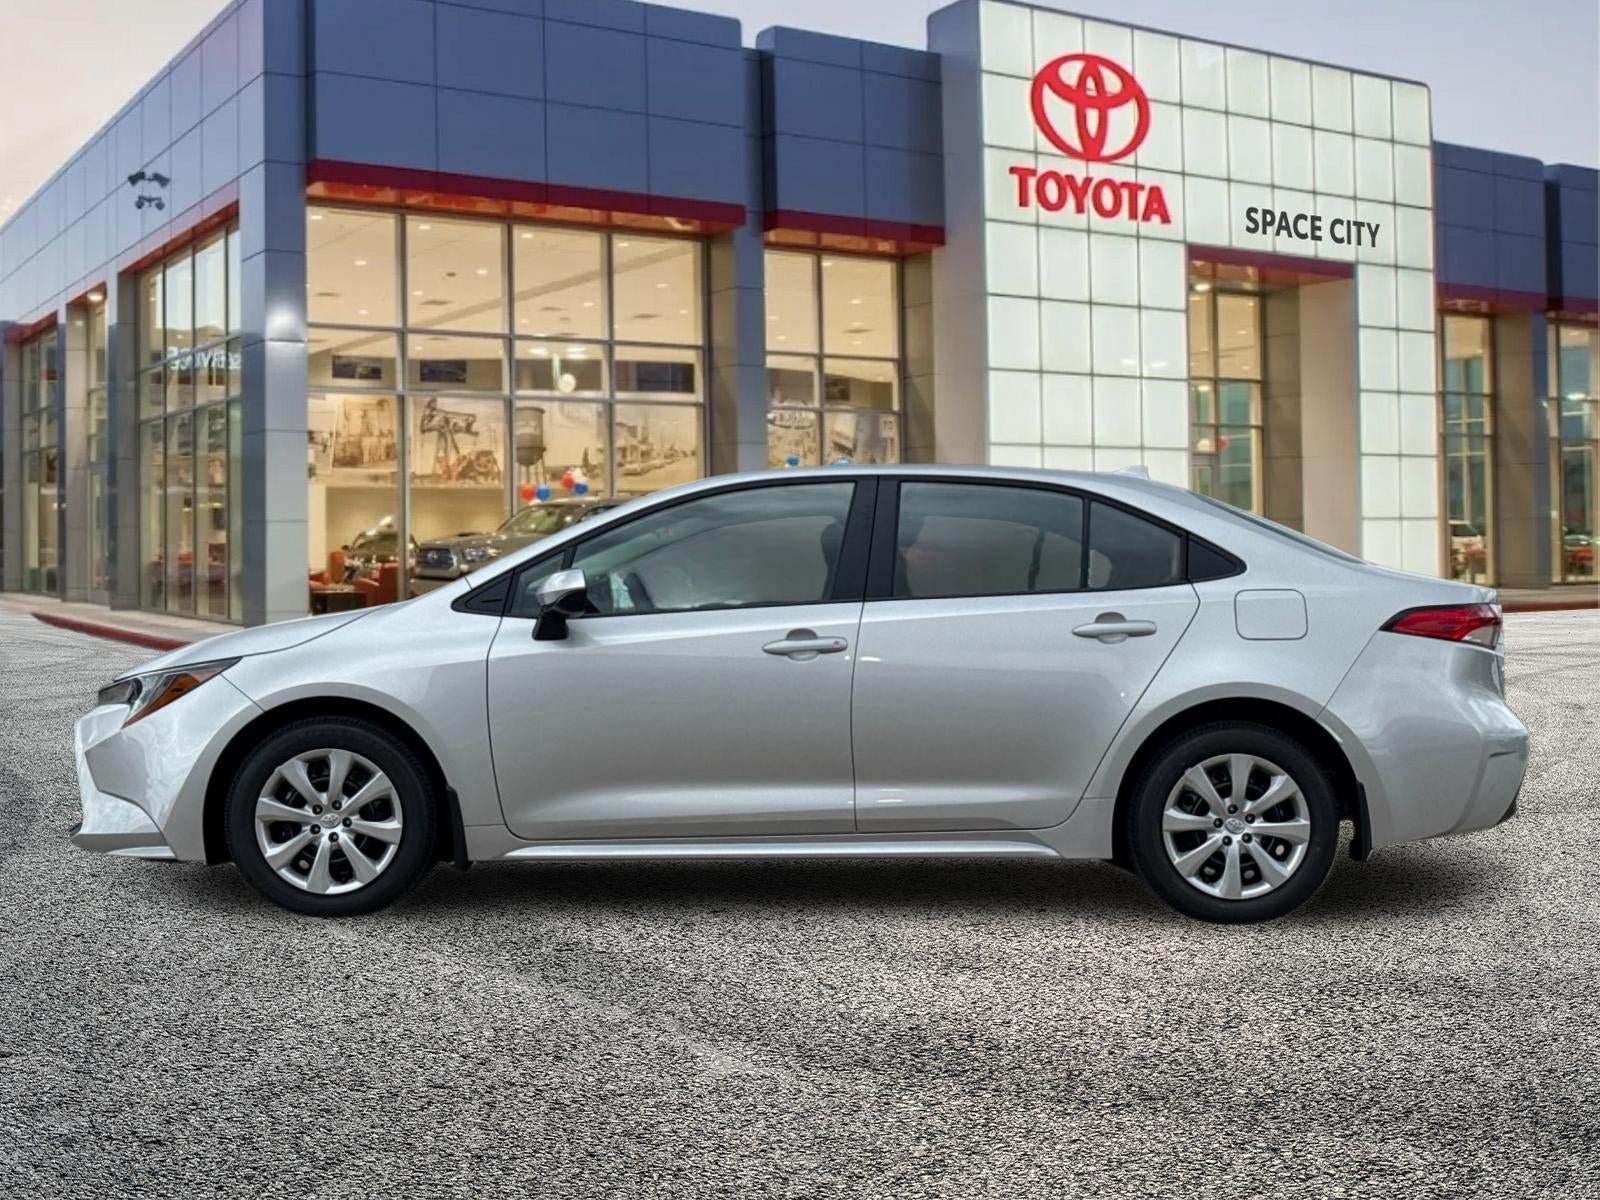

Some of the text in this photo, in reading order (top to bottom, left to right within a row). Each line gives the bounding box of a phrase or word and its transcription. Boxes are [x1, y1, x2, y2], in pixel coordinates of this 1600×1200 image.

[1009, 166, 1171, 224] TOYOTA
[1245, 206, 1380, 248] SPACE CITY
